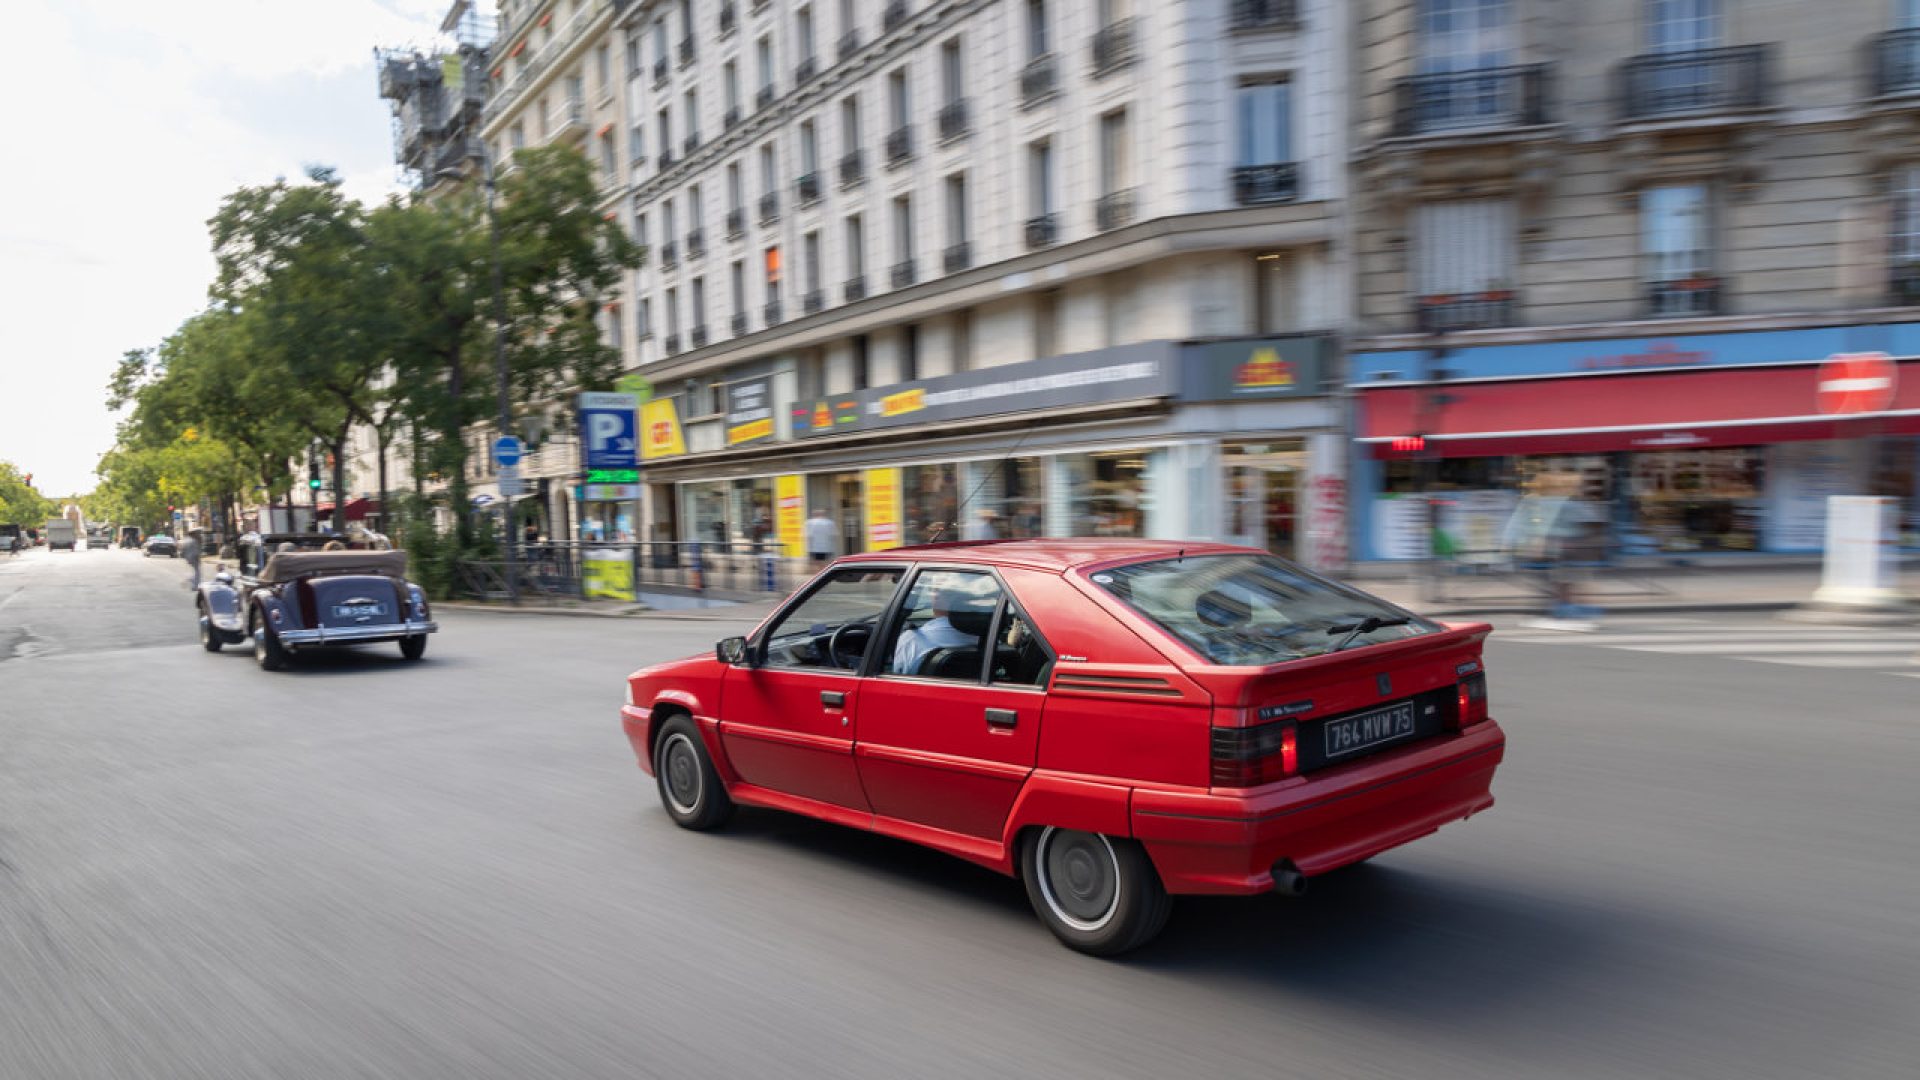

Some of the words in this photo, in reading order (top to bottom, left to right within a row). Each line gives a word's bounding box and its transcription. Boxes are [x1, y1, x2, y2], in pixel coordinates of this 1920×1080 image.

[588, 413, 624, 451] P
[1331, 720, 1360, 750] 764
[1392, 707, 1411, 733] 75
